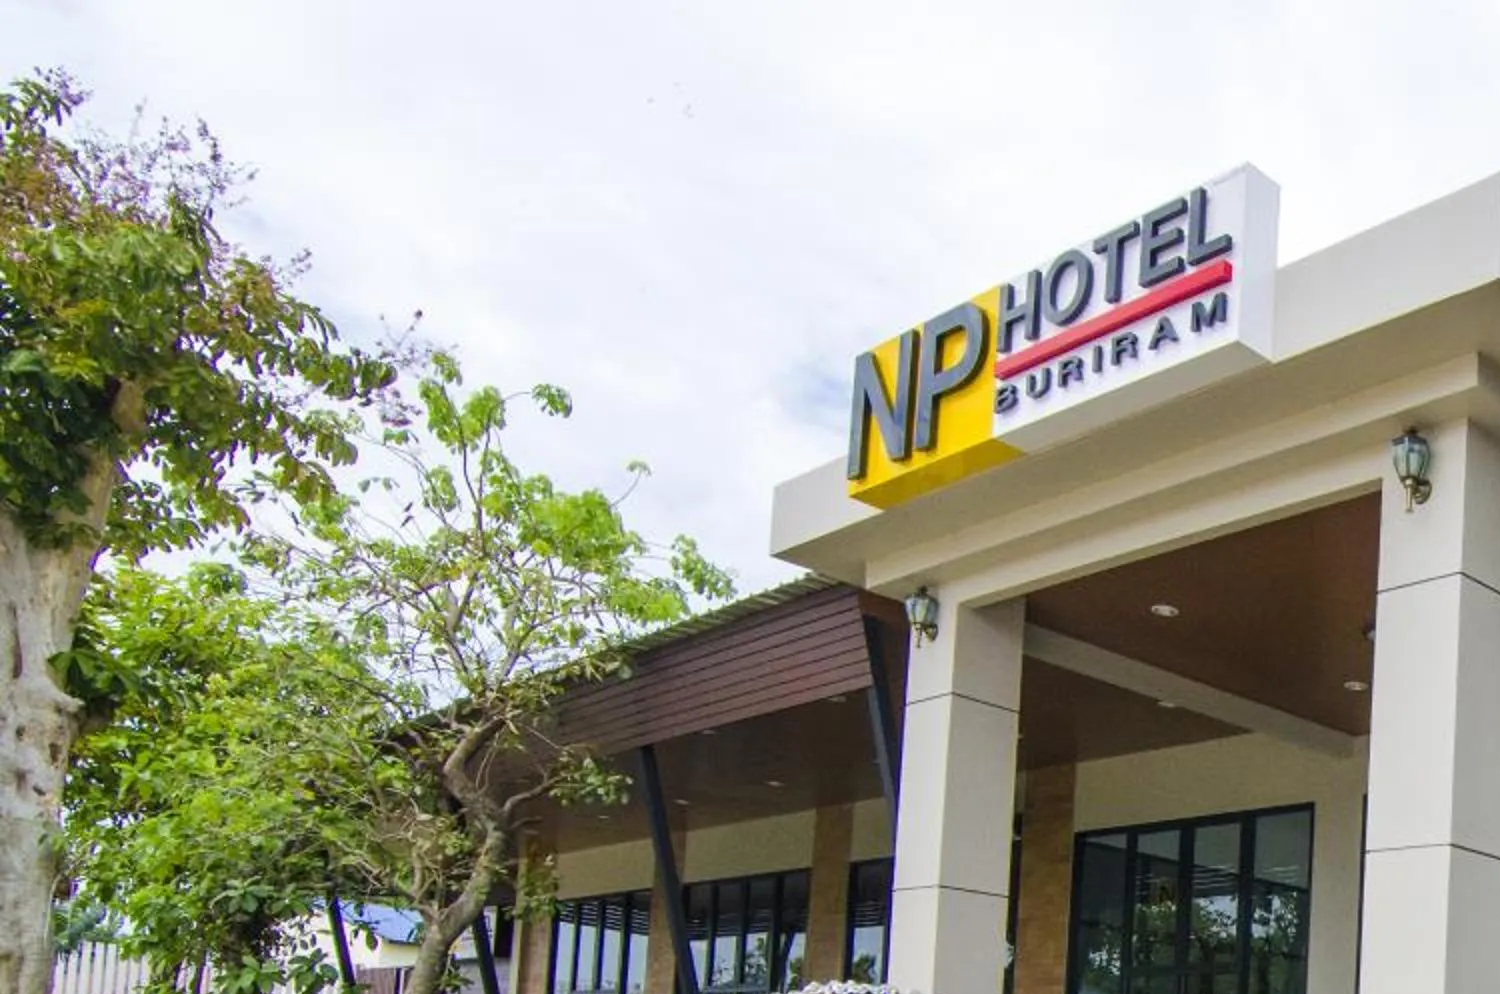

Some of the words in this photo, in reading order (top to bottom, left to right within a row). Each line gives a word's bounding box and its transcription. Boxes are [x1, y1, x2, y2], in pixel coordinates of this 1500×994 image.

[847, 301, 990, 481] NP
[996, 186, 1232, 353] HOTEL
[994, 292, 1228, 415] BURIRAM
